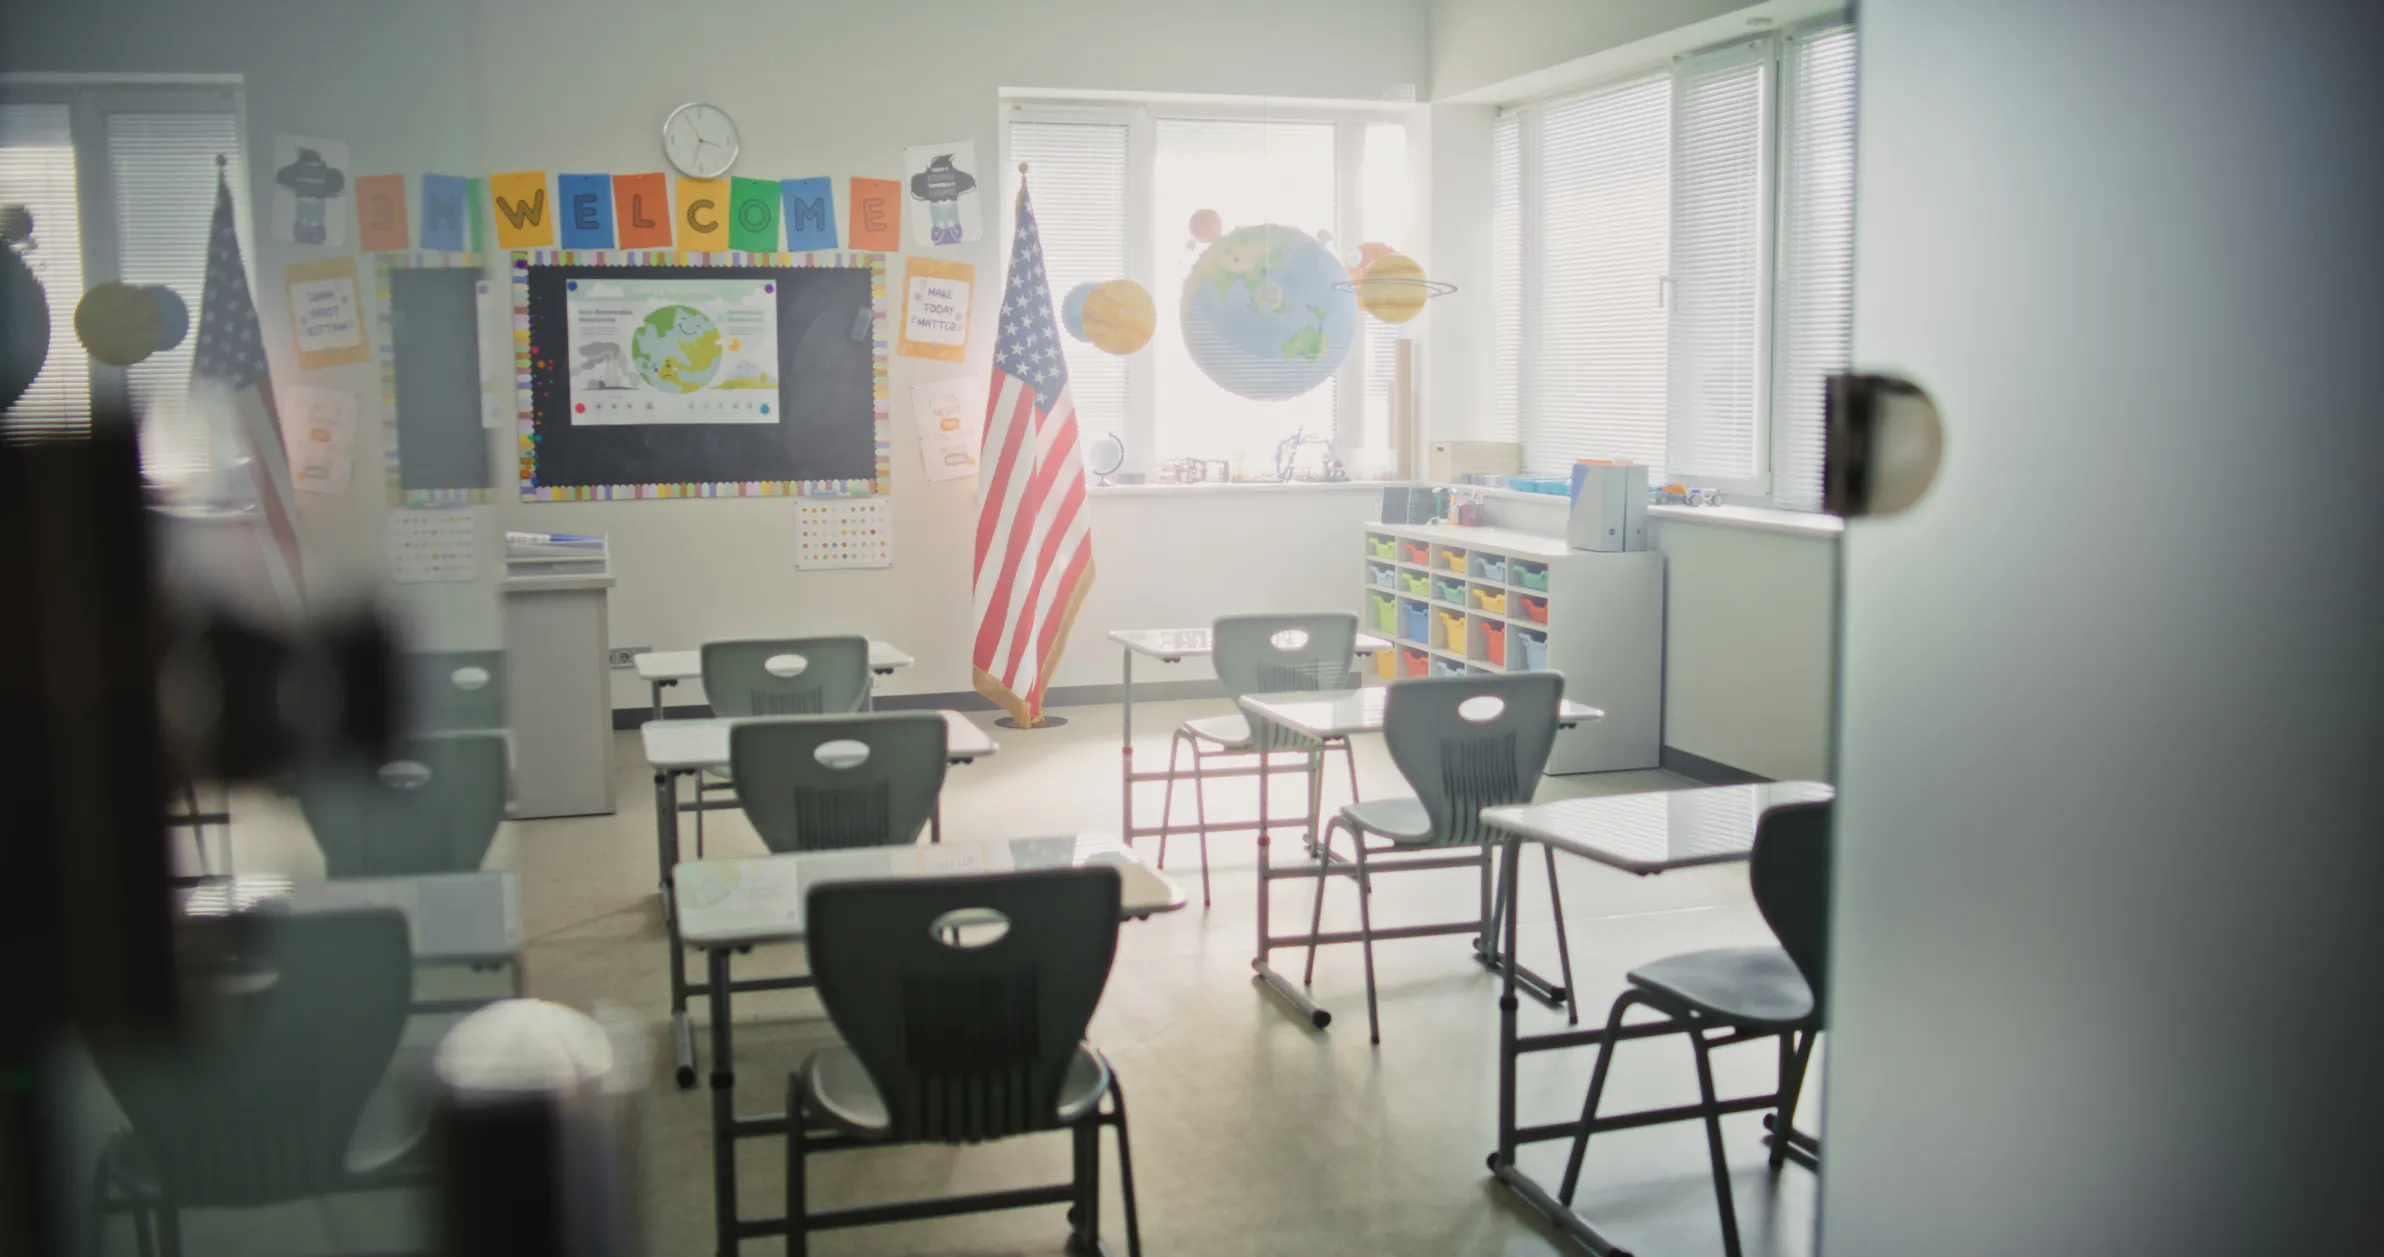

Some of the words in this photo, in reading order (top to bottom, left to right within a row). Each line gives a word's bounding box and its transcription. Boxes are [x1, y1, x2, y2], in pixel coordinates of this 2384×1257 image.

[928, 288, 953, 299] MAKE
[923, 303, 956, 316] TODAY
[917, 318, 957, 331] MATTER
